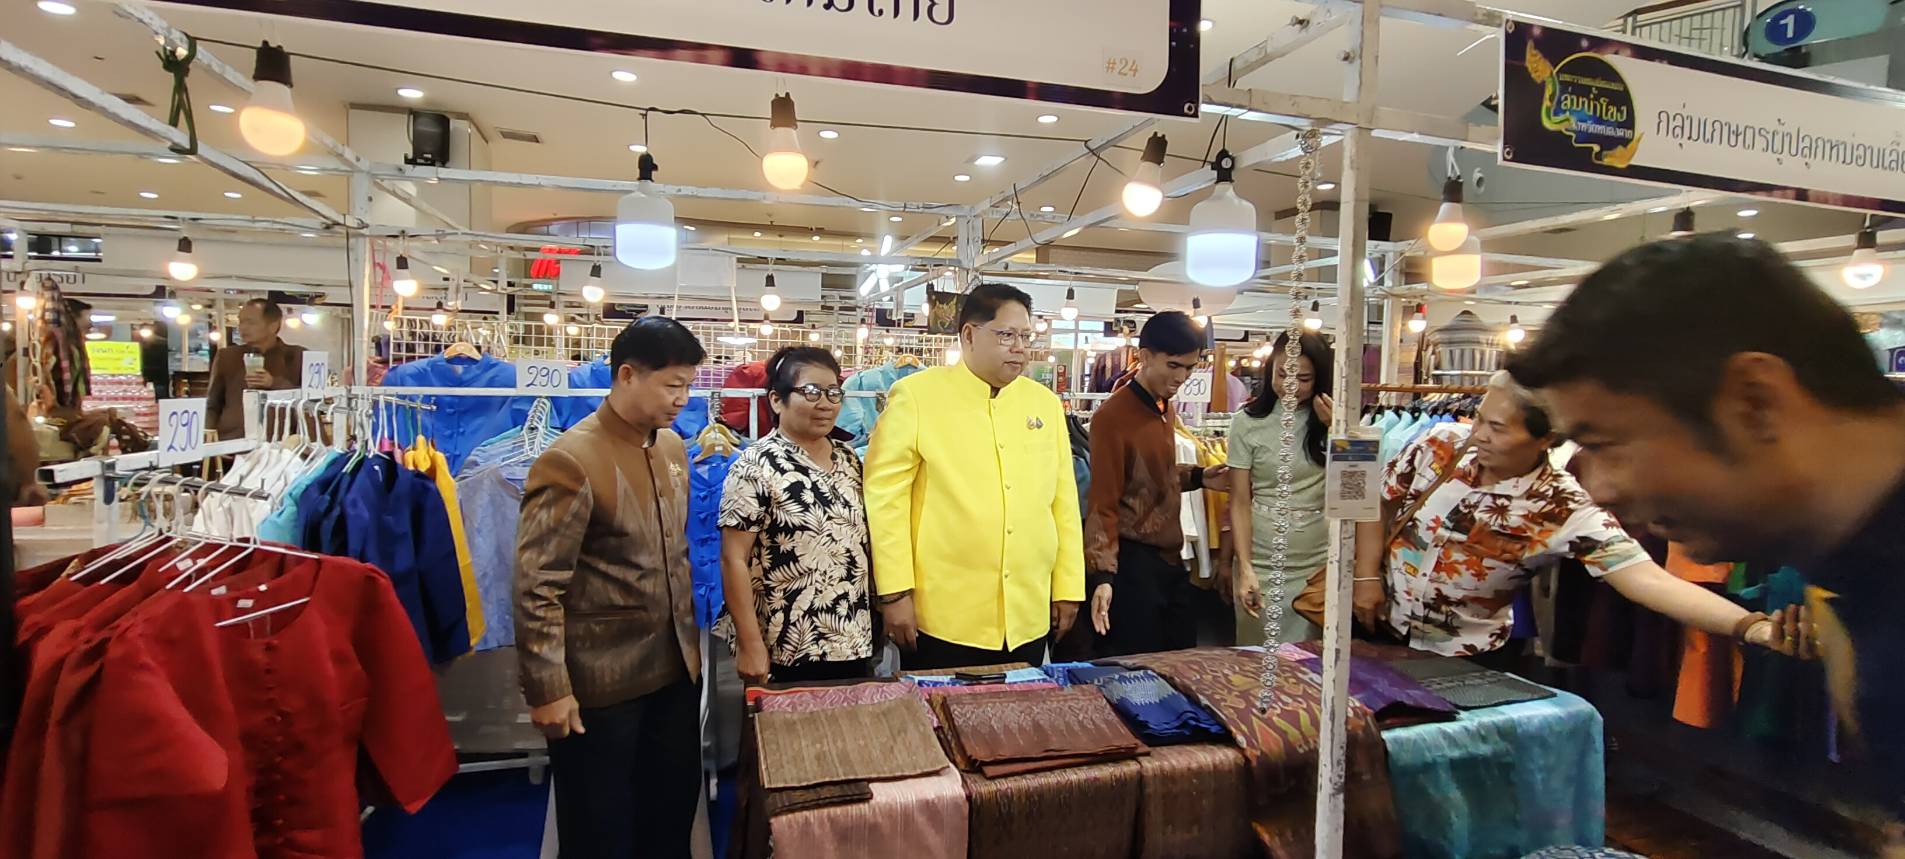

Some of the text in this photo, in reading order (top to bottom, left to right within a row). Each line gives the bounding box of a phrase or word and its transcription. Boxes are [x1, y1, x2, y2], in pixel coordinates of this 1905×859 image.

[1780, 14, 1795, 38] 1
[1105, 57, 1139, 78] #24
[307, 362, 326, 390] 290
[525, 365, 562, 388] 290
[166, 409, 200, 452] 290
